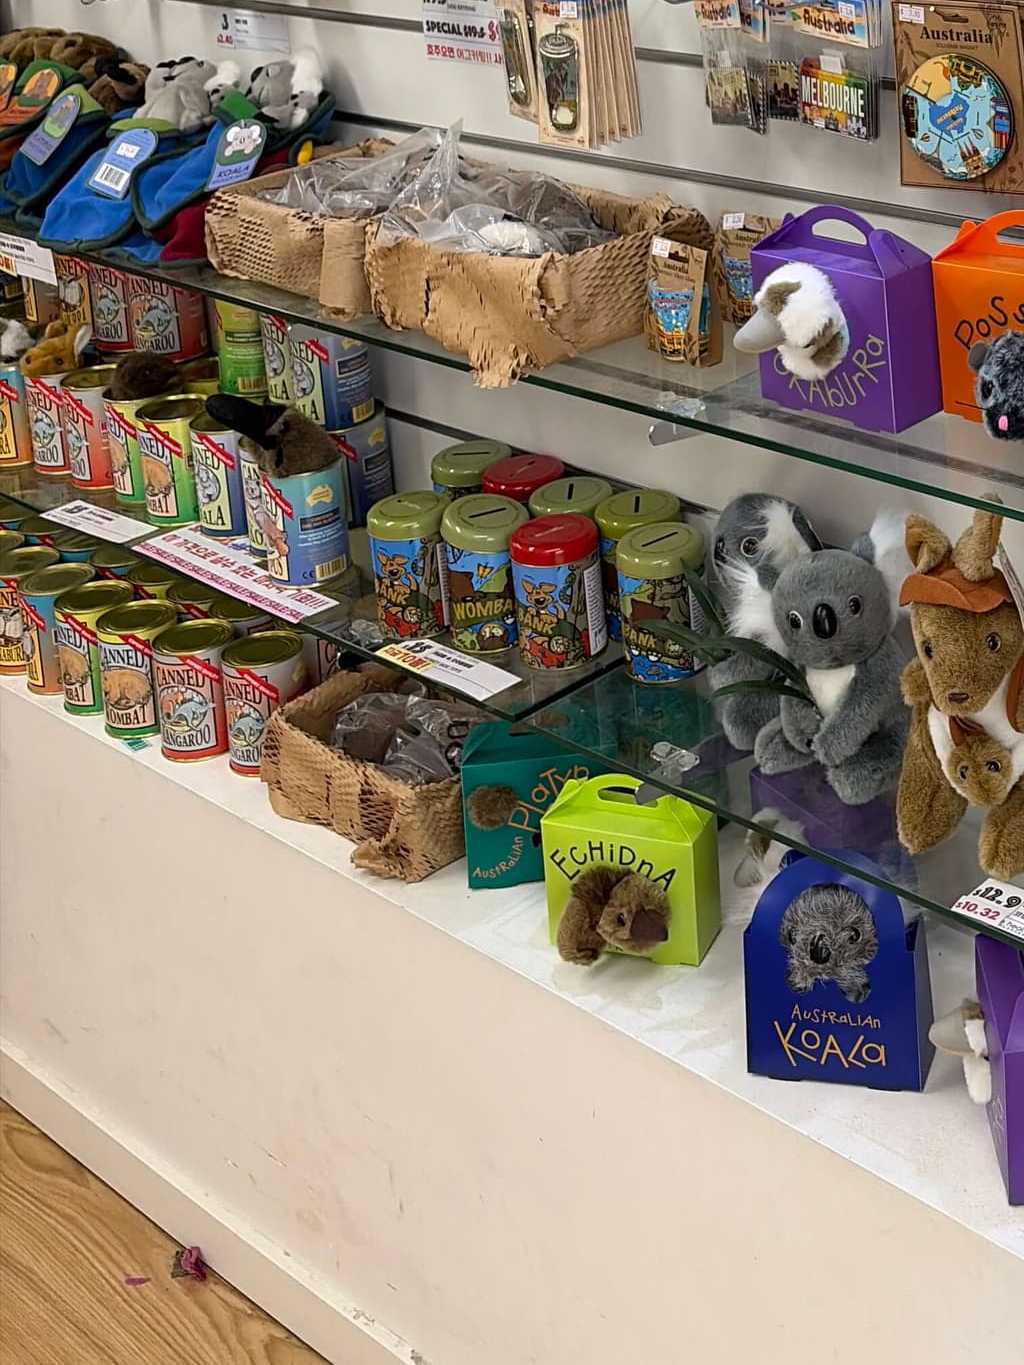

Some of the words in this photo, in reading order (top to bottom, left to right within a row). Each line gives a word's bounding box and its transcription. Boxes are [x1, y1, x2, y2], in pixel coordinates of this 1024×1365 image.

[425, 20, 463, 36] SPECIAL
[803, 8, 855, 35] Australia
[920, 25, 993, 45] Australia
[801, 74, 865, 118] MELBOURNE
[452, 599, 513, 620] WOMBA
[517, 608, 553, 635] BANK
[624, 624, 657, 649] BANK
[156, 665, 205, 688] CANNED
[223, 678, 262, 704] ANNED
[972, 886, 1022, 909] $12.9
[955, 900, 1001, 922] $10.32
